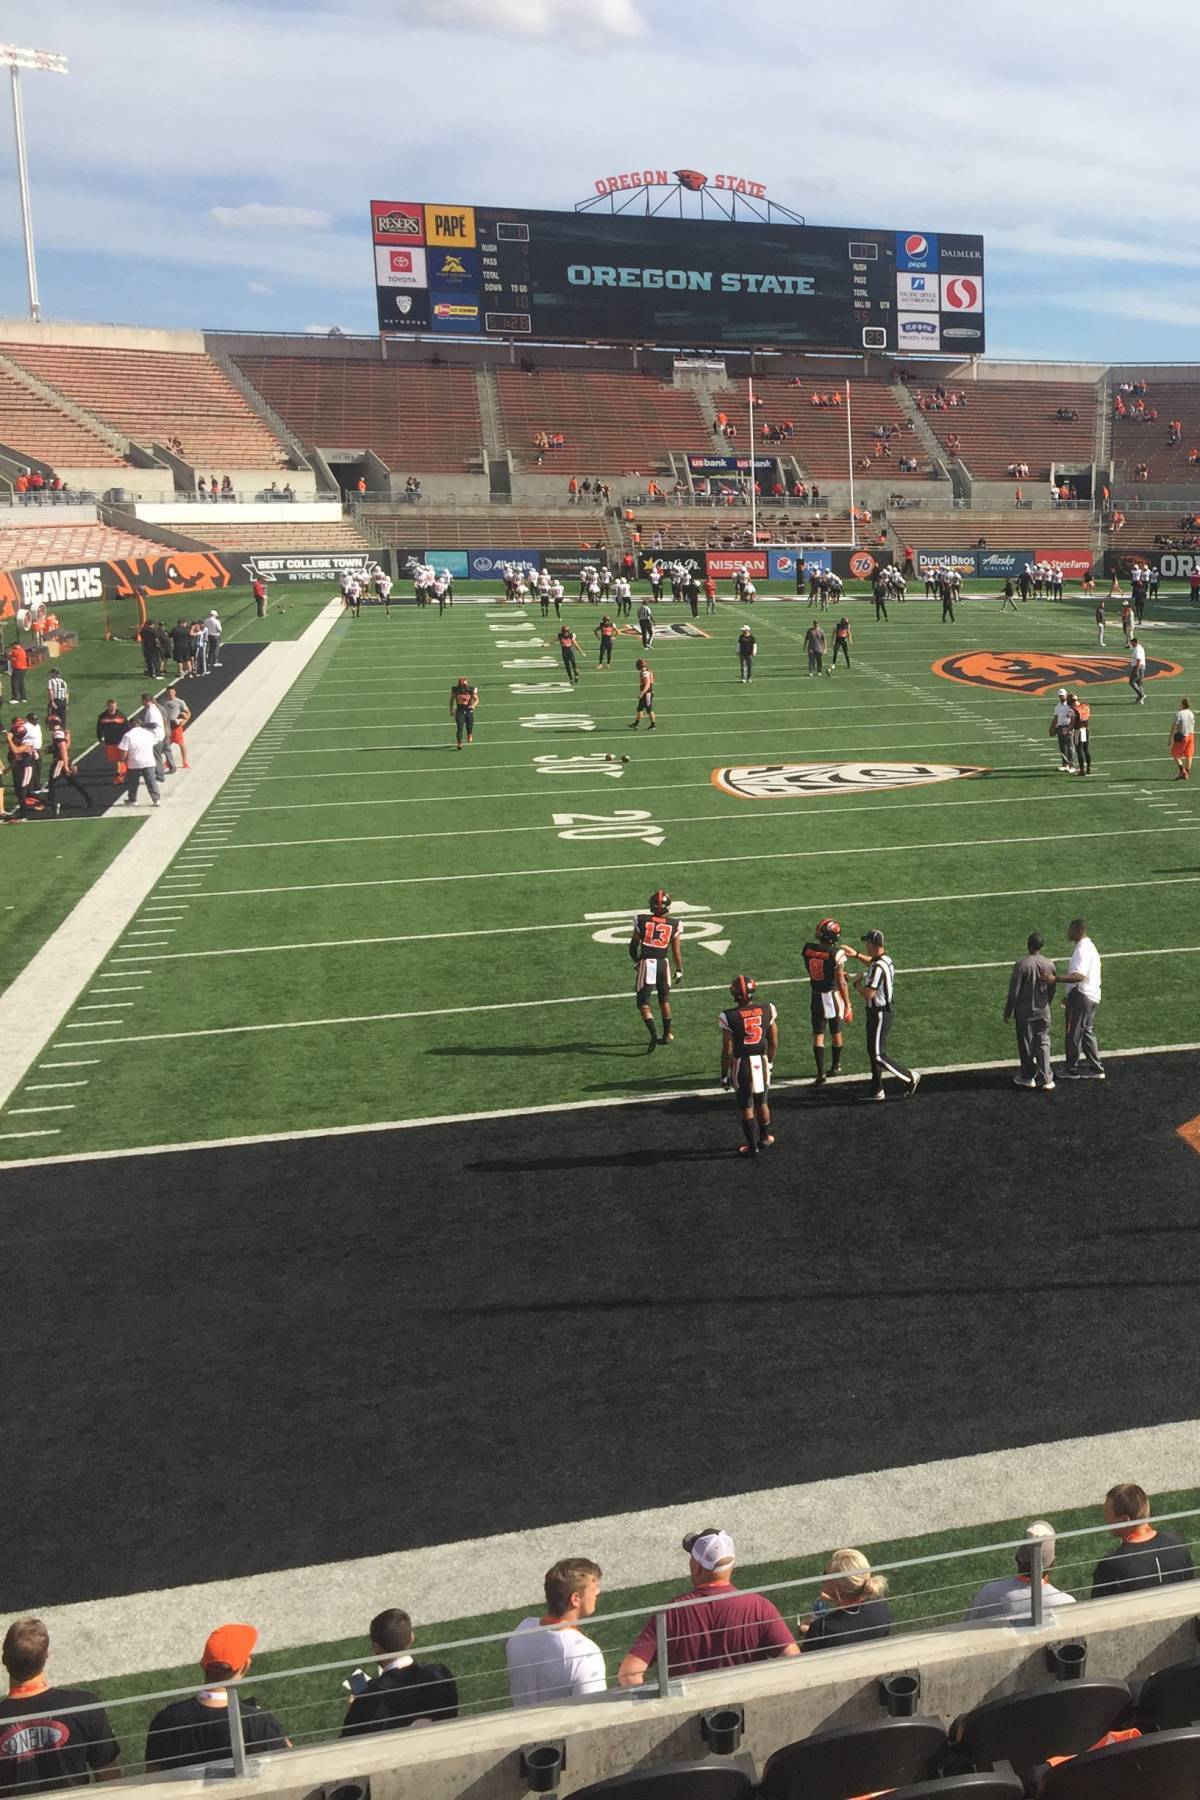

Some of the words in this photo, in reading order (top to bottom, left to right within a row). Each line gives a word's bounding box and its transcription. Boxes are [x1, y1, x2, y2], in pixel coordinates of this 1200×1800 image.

[594, 169, 668, 195] OREGON
[714, 174, 768, 199] STATE
[941, 249, 982, 259] DAIMLER
[482, 257, 498, 266] PASS
[907, 261, 928, 269] pepsi
[387, 276, 417, 284] TOYOTA
[482, 271, 500, 280] TOTAL
[566, 264, 713, 292] OREGON
[720, 272, 816, 295] STATE
[853, 276, 867, 285] PASS
[853, 288, 869, 297] TOTAL
[257, 559, 286, 570] BEST
[287, 558, 333, 569] COLLEGE
[332, 557, 363, 568] TOWN
[708, 558, 766, 571] NISSAN
[855, 557, 876, 570] 76
[981, 553, 1016, 565] Alaska
[288, 573, 298, 581] IN
[297, 573, 312, 581] THE
[312, 572, 336, 581] PAC-12
[20, 567, 103, 605] BEAVERS
[551, 809, 666, 841] 20
[644, 921, 674, 949] 13
[743, 1015, 763, 1045] 5
